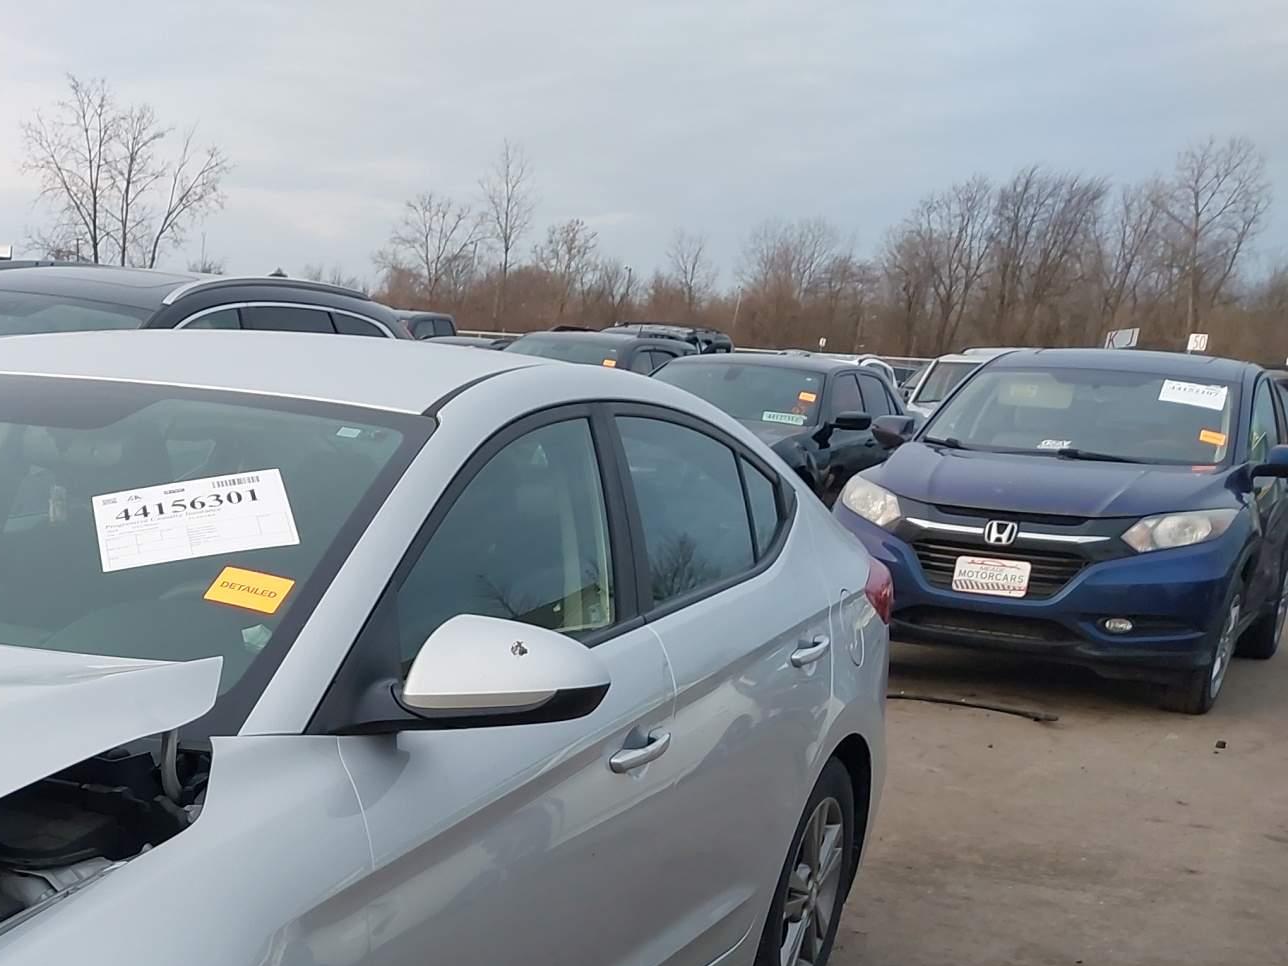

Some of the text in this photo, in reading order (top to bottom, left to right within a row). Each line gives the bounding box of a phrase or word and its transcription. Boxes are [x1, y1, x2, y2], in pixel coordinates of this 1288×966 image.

[1193, 335, 1207, 349] 50
[115, 489, 258, 521] 44156301
[958, 569, 1025, 584] MOTORCARS
[220, 580, 277, 599] DETAILED
